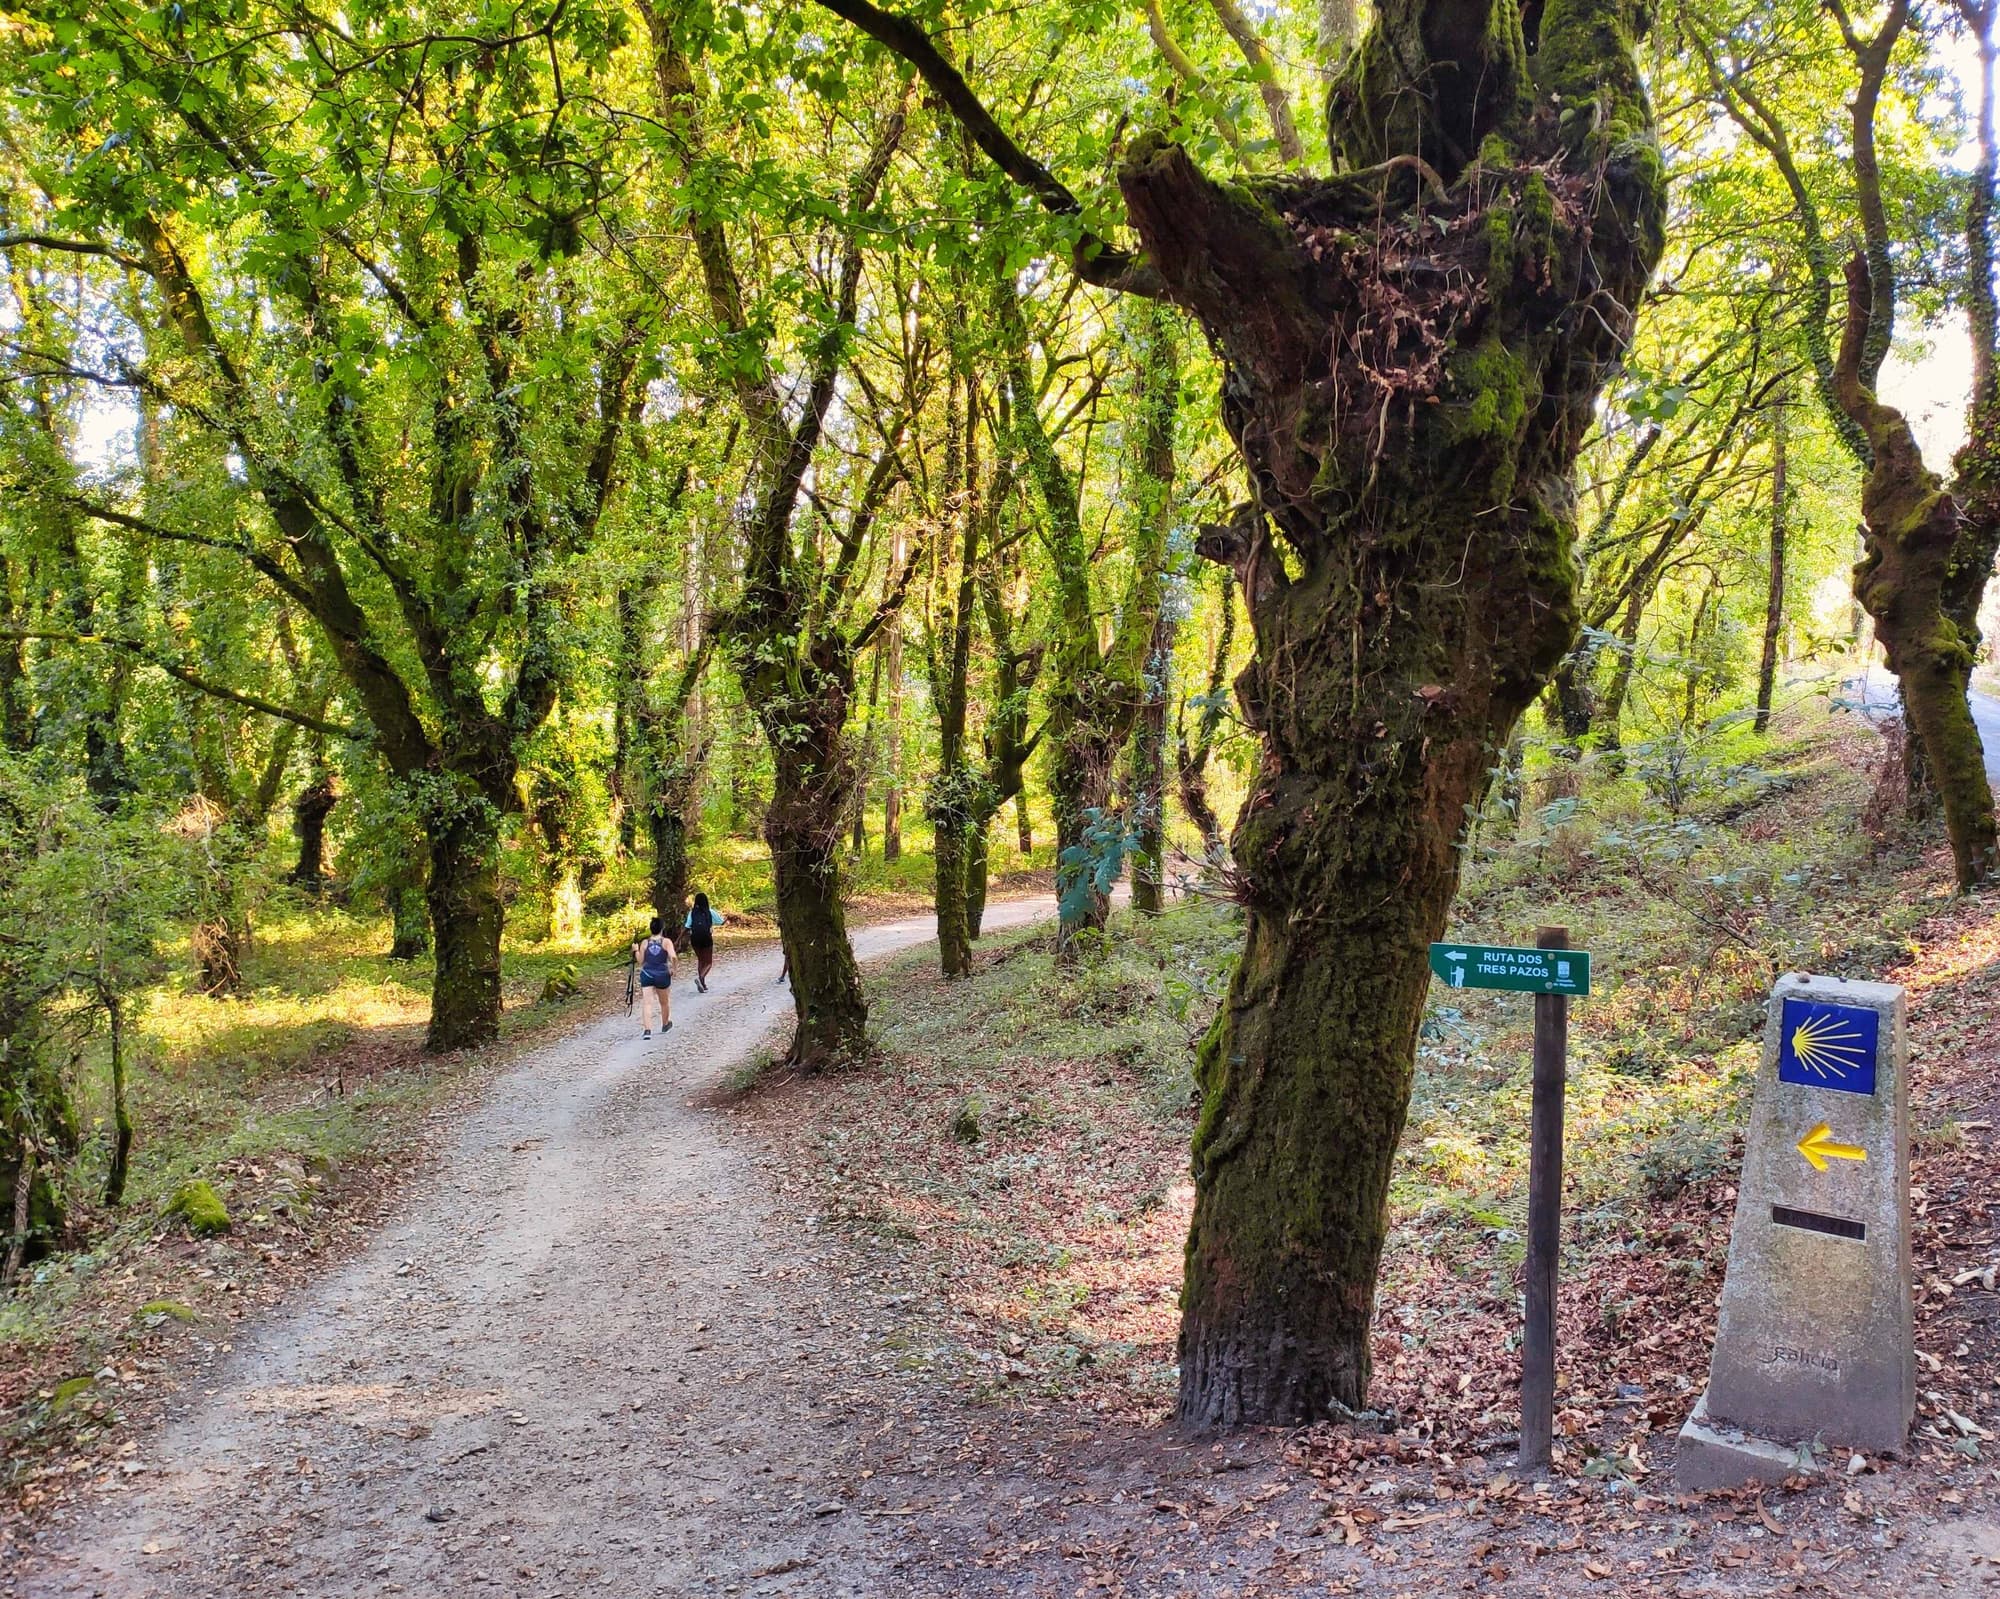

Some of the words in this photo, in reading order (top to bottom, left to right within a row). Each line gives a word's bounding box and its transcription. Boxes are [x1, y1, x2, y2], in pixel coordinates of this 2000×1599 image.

[1484, 952, 1514, 962] RUTA
[1518, 954, 1542, 964] DOS
[1477, 964, 1506, 974] TRES
[1510, 966, 1549, 977] PAZOS
